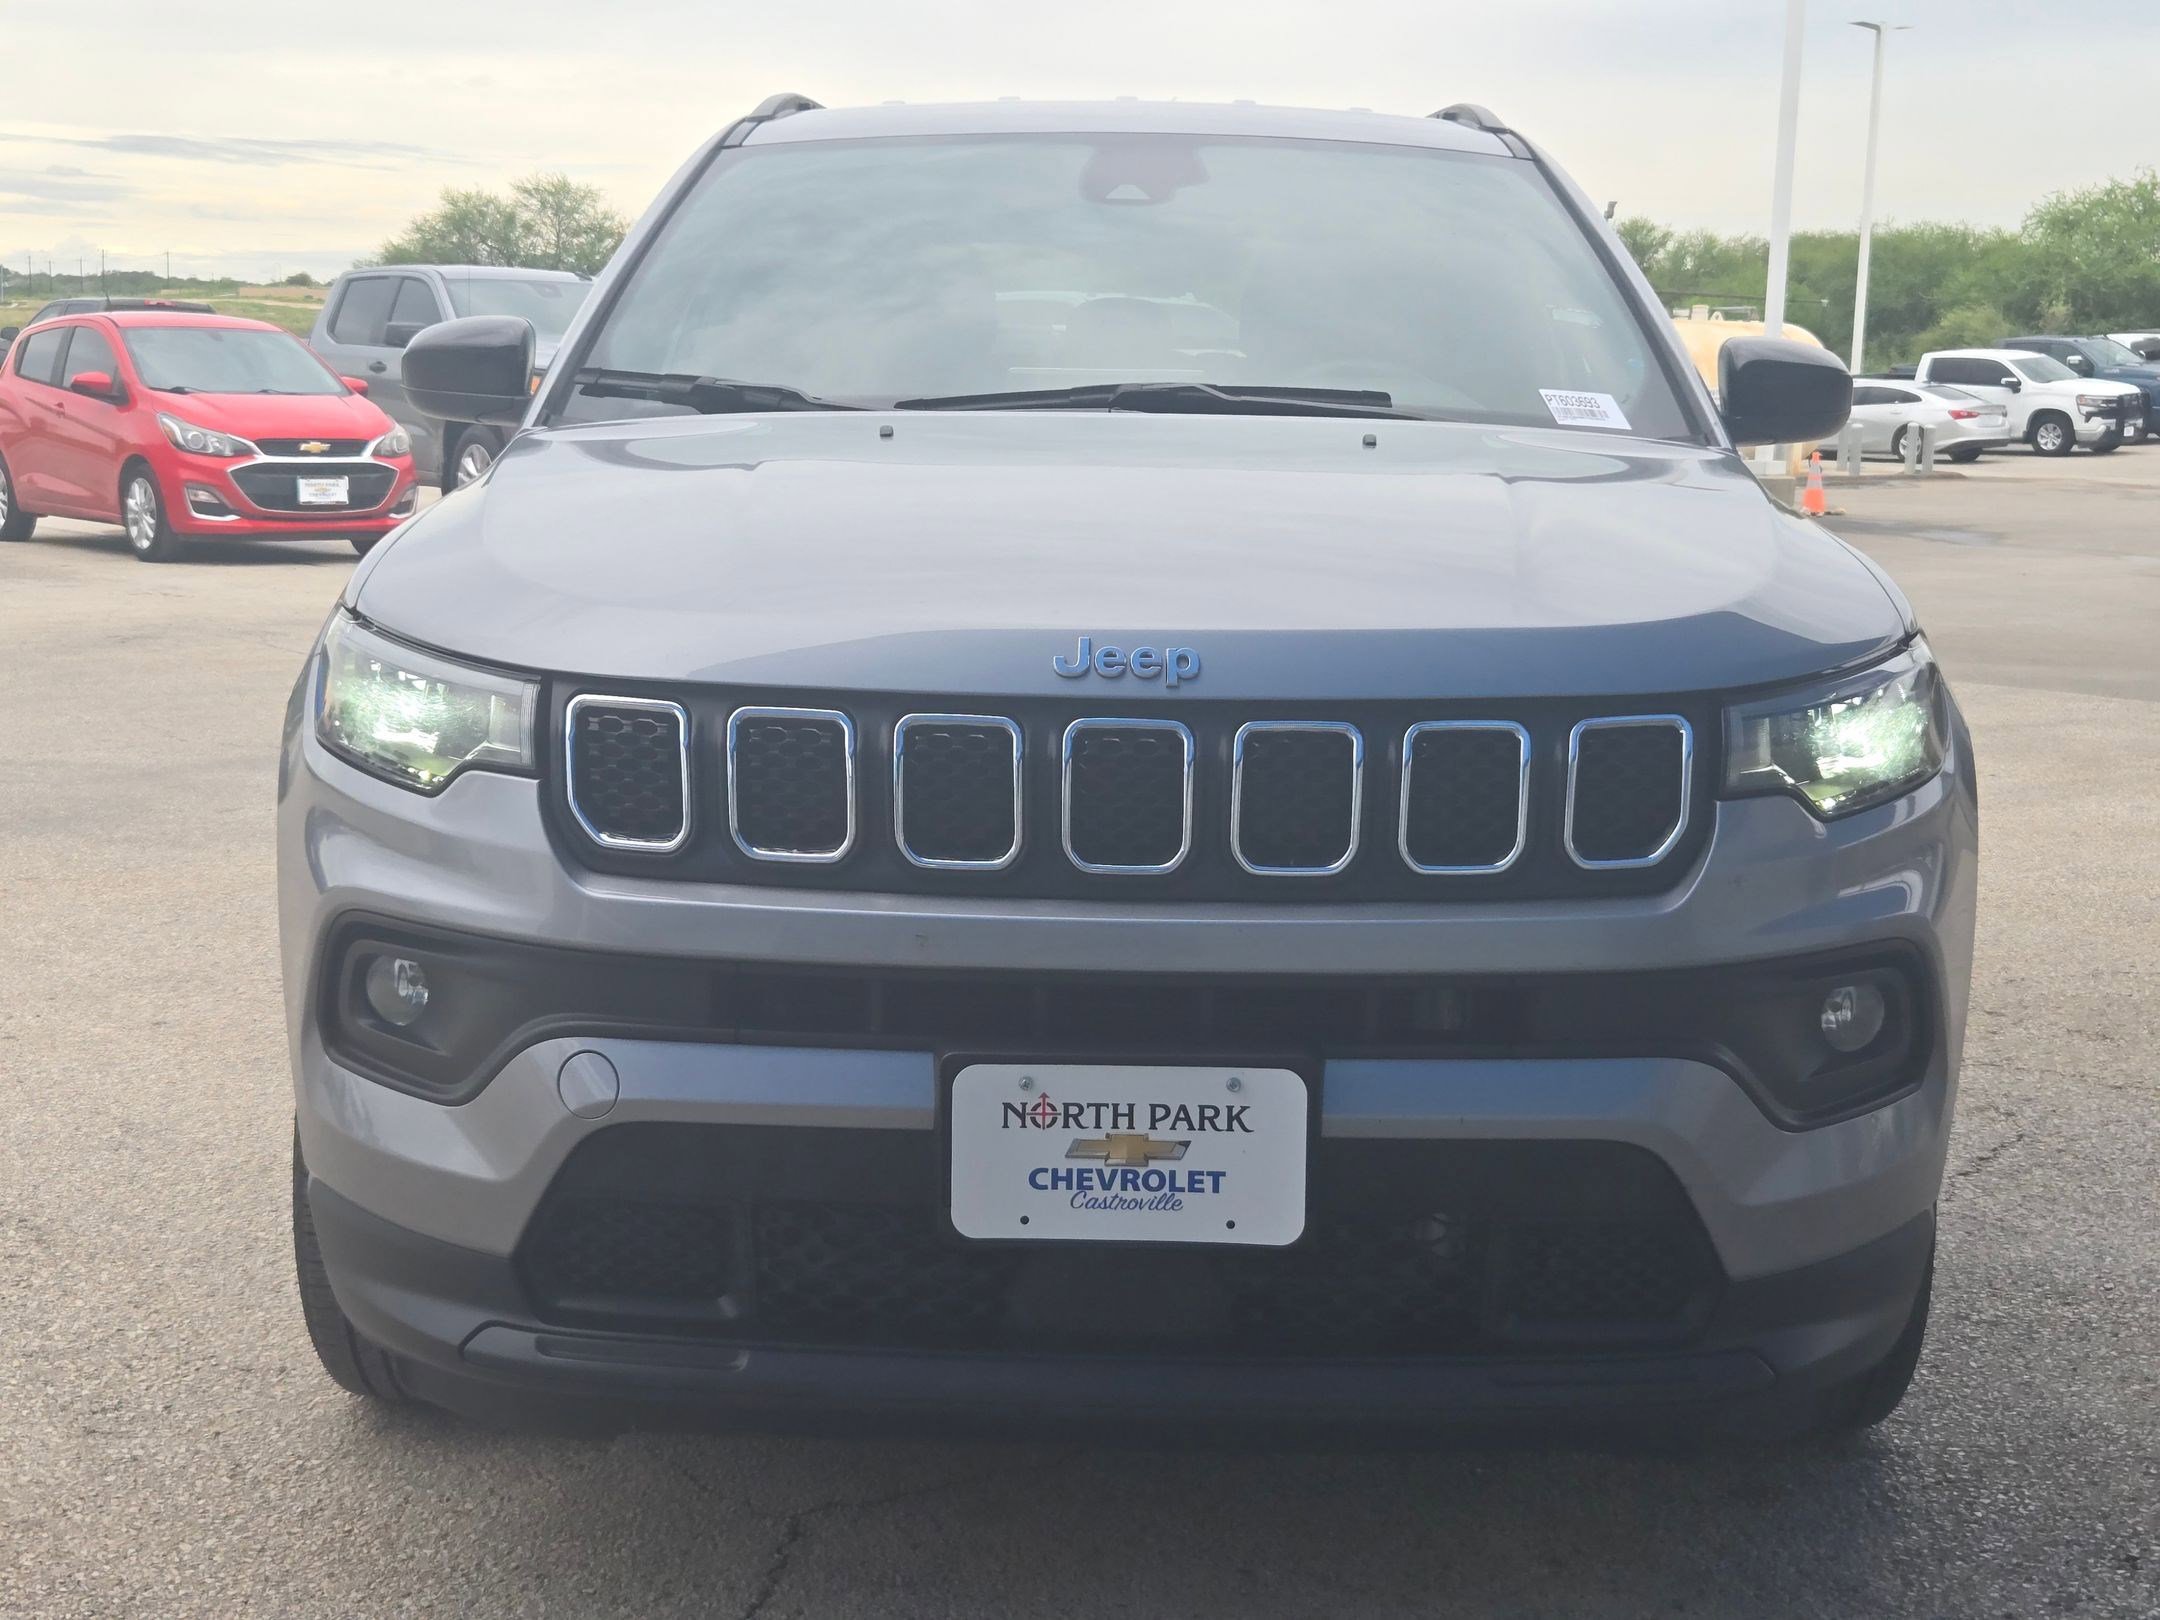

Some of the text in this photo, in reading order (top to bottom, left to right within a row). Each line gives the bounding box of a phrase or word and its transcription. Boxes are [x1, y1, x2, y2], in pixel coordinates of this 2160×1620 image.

[1053, 636, 1200, 688] Jeep
[1001, 1095, 1255, 1133] NORTH PARK
[1028, 1167, 1226, 1194] CHEVROLET
[1069, 1190, 1184, 1212] Castroville
